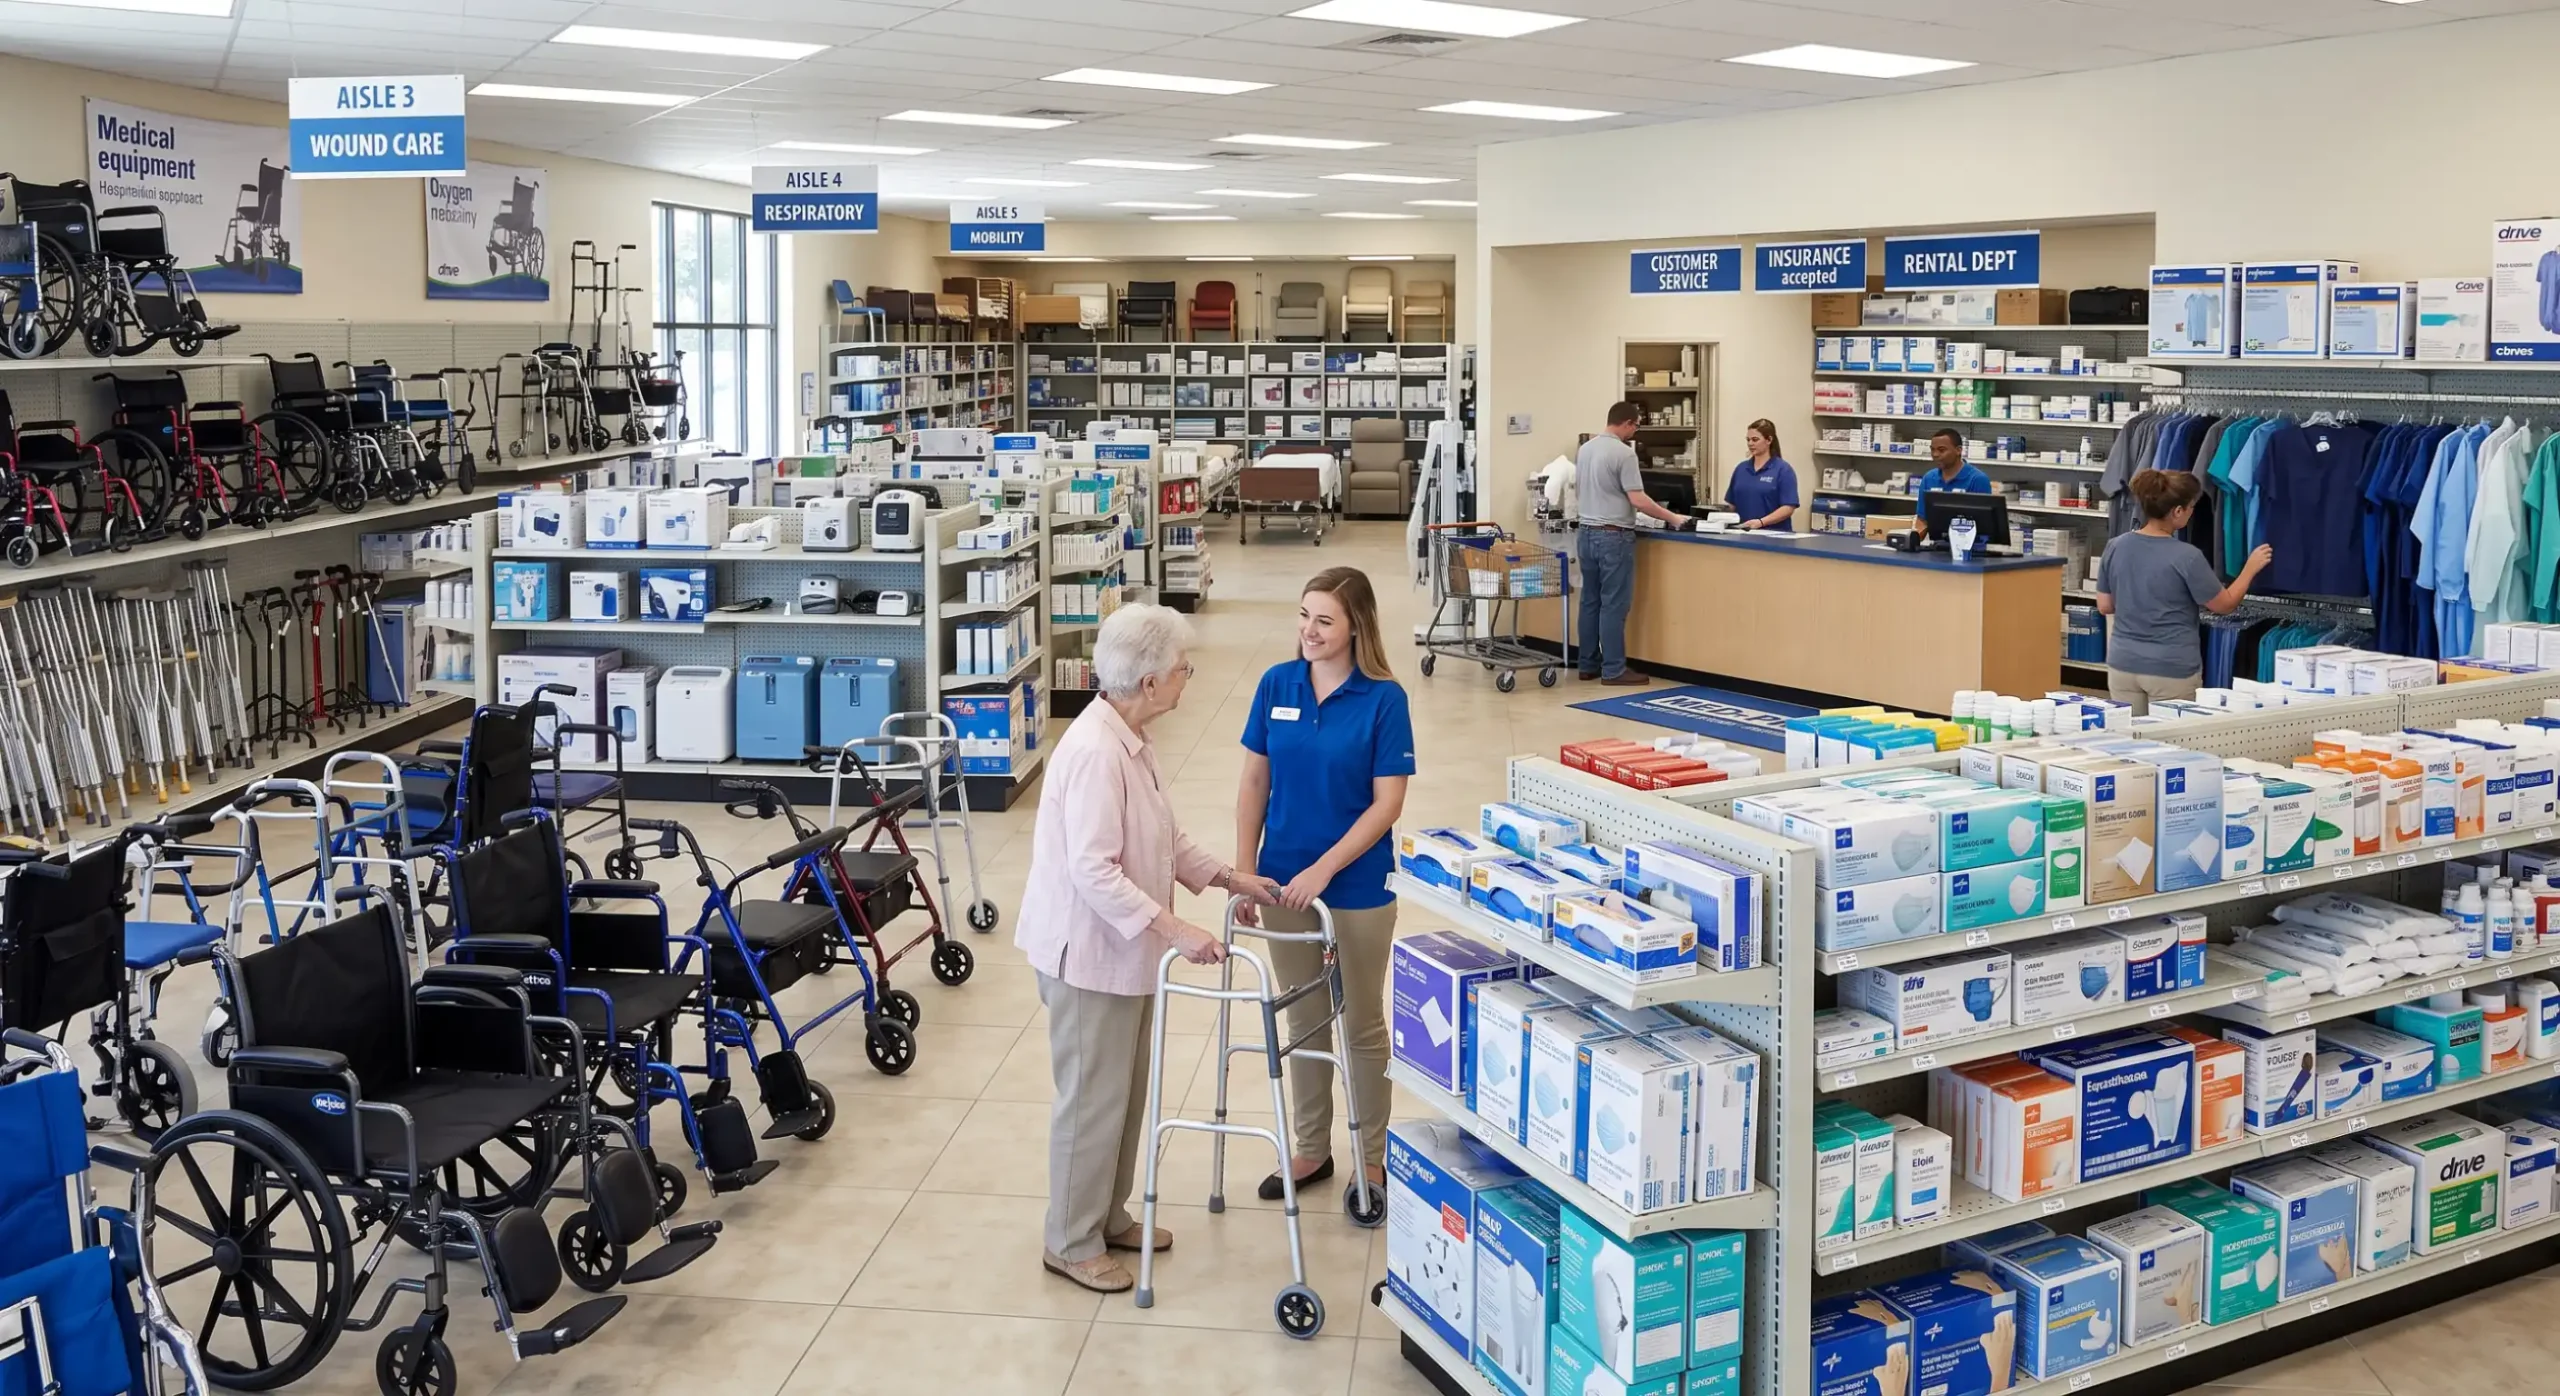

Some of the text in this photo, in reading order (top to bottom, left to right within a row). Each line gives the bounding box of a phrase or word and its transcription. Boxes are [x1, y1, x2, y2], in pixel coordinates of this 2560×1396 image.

[337, 85, 415, 109] AISLE 3
[98, 114, 175, 150] Medical
[310, 131, 444, 158] WOUND CARE
[98, 149, 196, 180] equipment
[786, 171, 842, 188] AISLE 4
[430, 177, 472, 205] Oxygen
[764, 203, 865, 221] RESPIRATORY
[976, 206, 1018, 219] AISLE 5
[970, 231, 1024, 245] MOBILITY
[2498, 226, 2542, 239] drive
[1650, 252, 1719, 272] CUSTOMER
[1768, 246, 1851, 268] INSURANCE
[1904, 250, 2017, 274] RENTAL DEPT
[1658, 272, 1709, 291] SERVICE
[1781, 269, 1837, 288] accepted
[2440, 1154, 2486, 1182] drive
